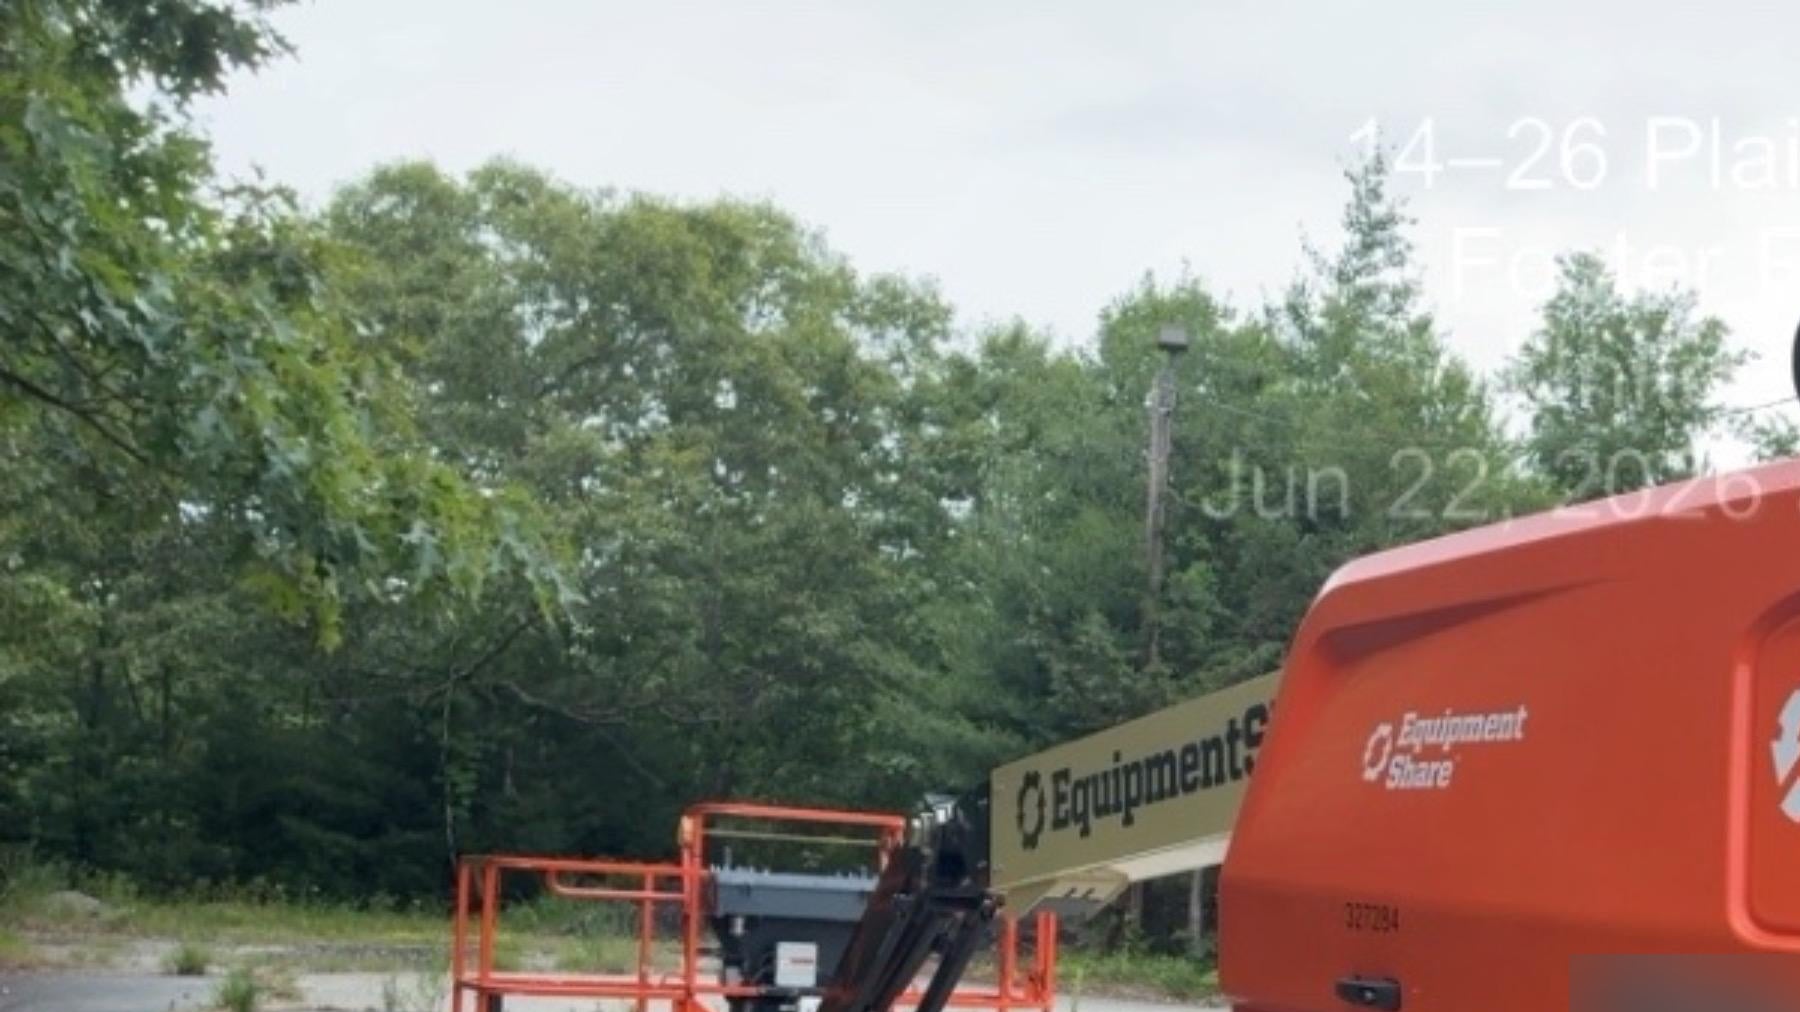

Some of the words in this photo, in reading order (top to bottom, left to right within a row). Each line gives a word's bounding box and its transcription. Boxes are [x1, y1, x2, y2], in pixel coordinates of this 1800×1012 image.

[1396, 704, 1528, 753] Equipment
[1386, 755, 1454, 788] Share
[1345, 901, 1399, 931] 327284
